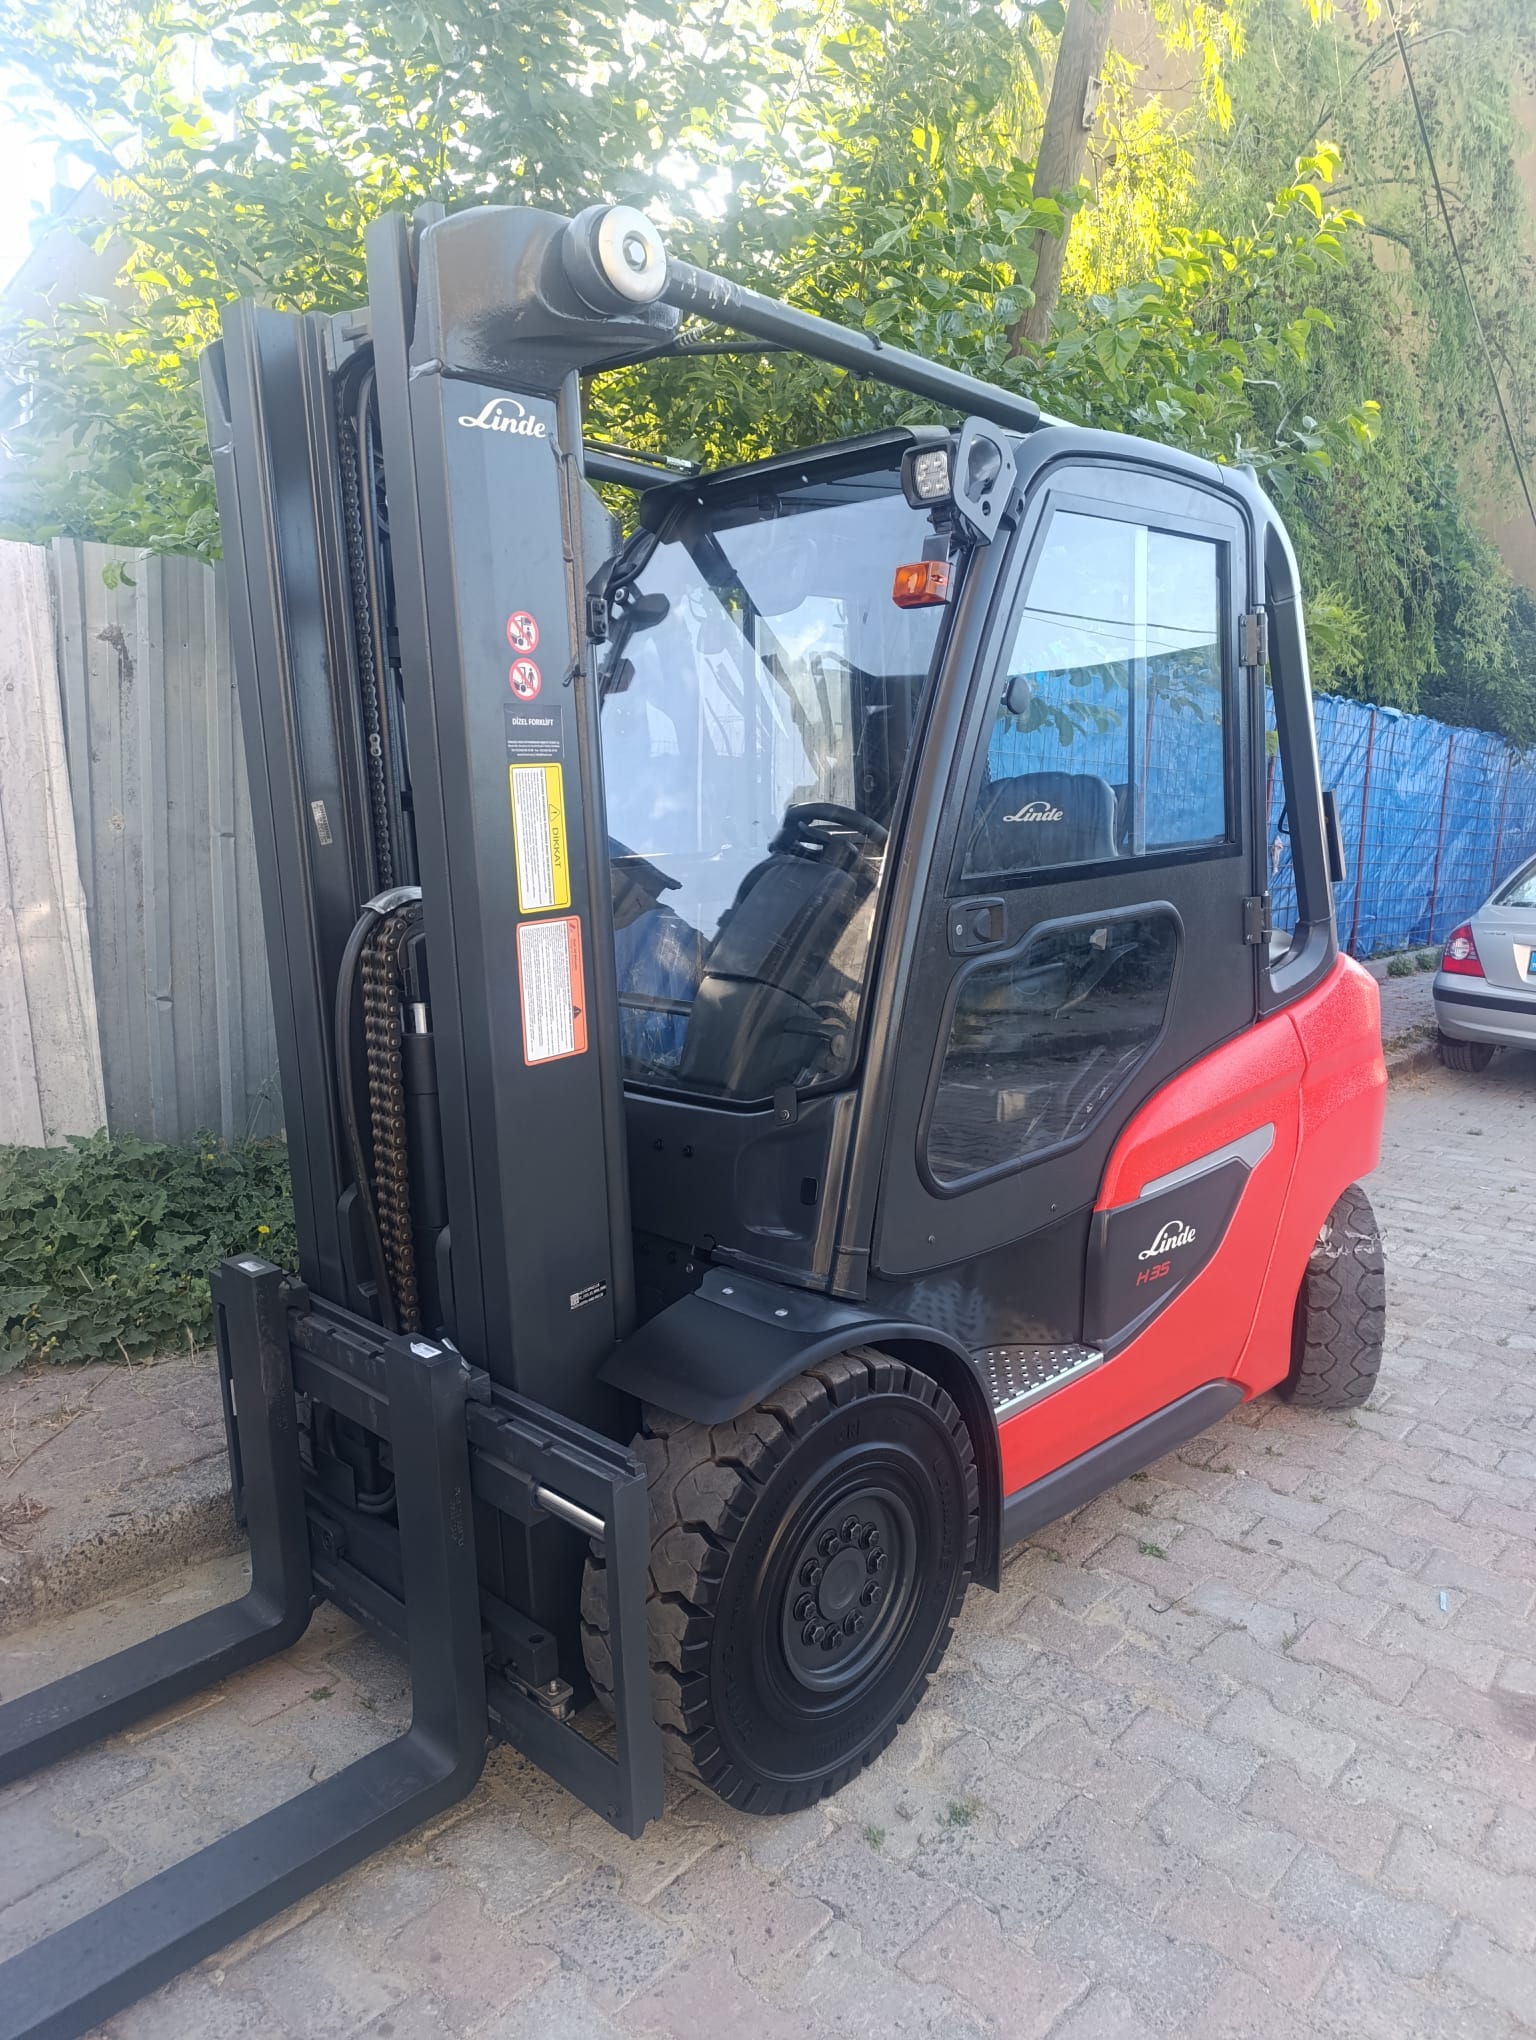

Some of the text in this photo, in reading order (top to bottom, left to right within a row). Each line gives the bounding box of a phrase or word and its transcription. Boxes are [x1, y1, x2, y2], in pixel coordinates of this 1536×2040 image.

[458, 398, 546, 438] Linde
[1002, 801, 1064, 822] Linde
[1138, 1220, 1196, 1260] Linde
[1136, 1260, 1171, 1286] H35
